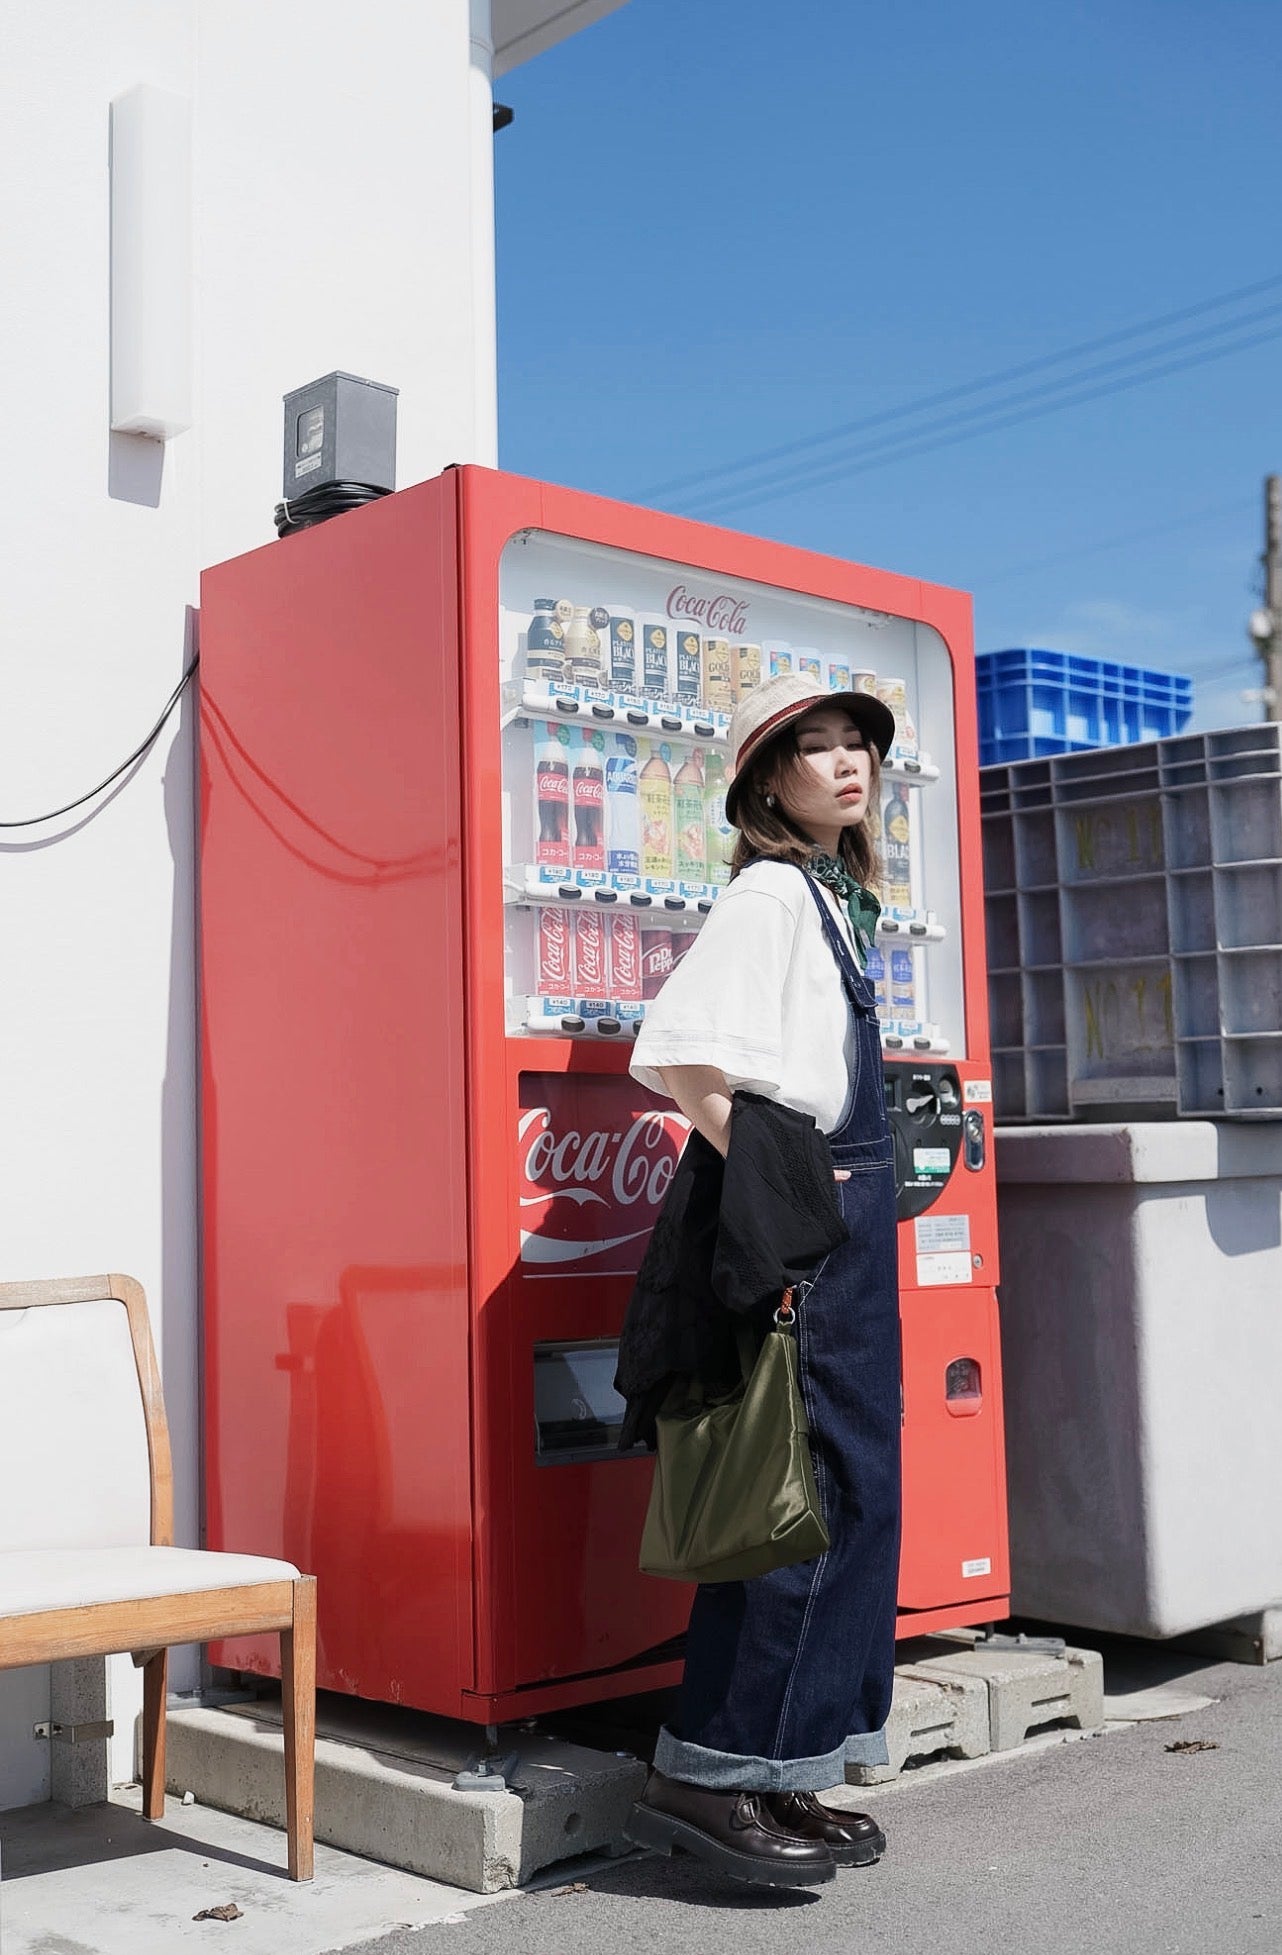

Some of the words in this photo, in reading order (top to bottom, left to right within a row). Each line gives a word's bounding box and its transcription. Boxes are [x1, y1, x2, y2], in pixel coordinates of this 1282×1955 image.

[666, 585, 750, 634] Coca-Cola
[613, 646, 635, 660] BLAC
[645, 653, 667, 667] BLAC
[679, 660, 701, 674] BLAC
[649, 952, 673, 973] Pepp
[519, 1107, 696, 1209] Coca-Co
